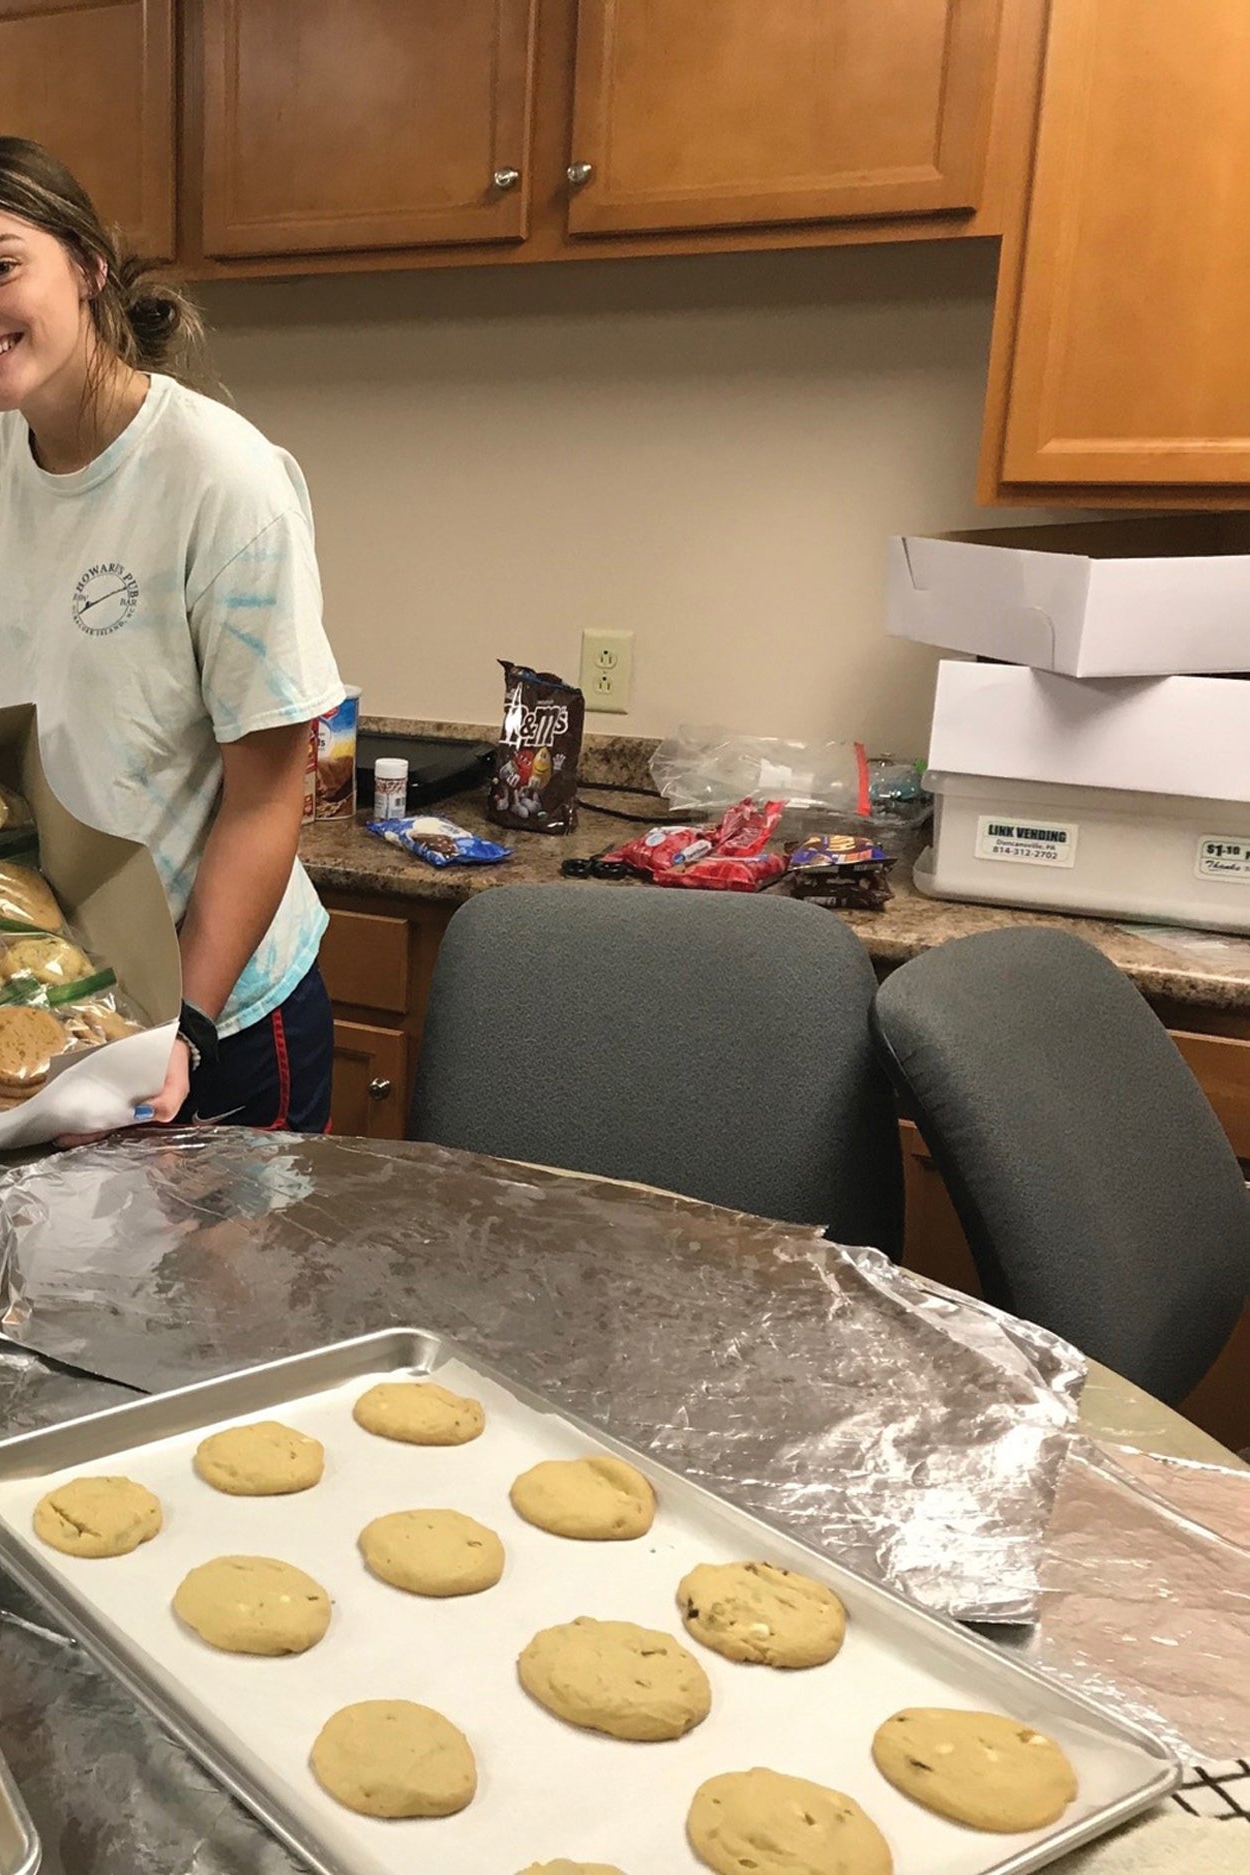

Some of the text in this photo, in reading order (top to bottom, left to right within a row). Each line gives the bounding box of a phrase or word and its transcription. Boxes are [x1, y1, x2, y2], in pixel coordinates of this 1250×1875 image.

[988, 824, 1067, 843] LINK VENDING
[992, 846, 1058, 860] 814-312-2702
[1205, 860, 1241, 872] Thanks
